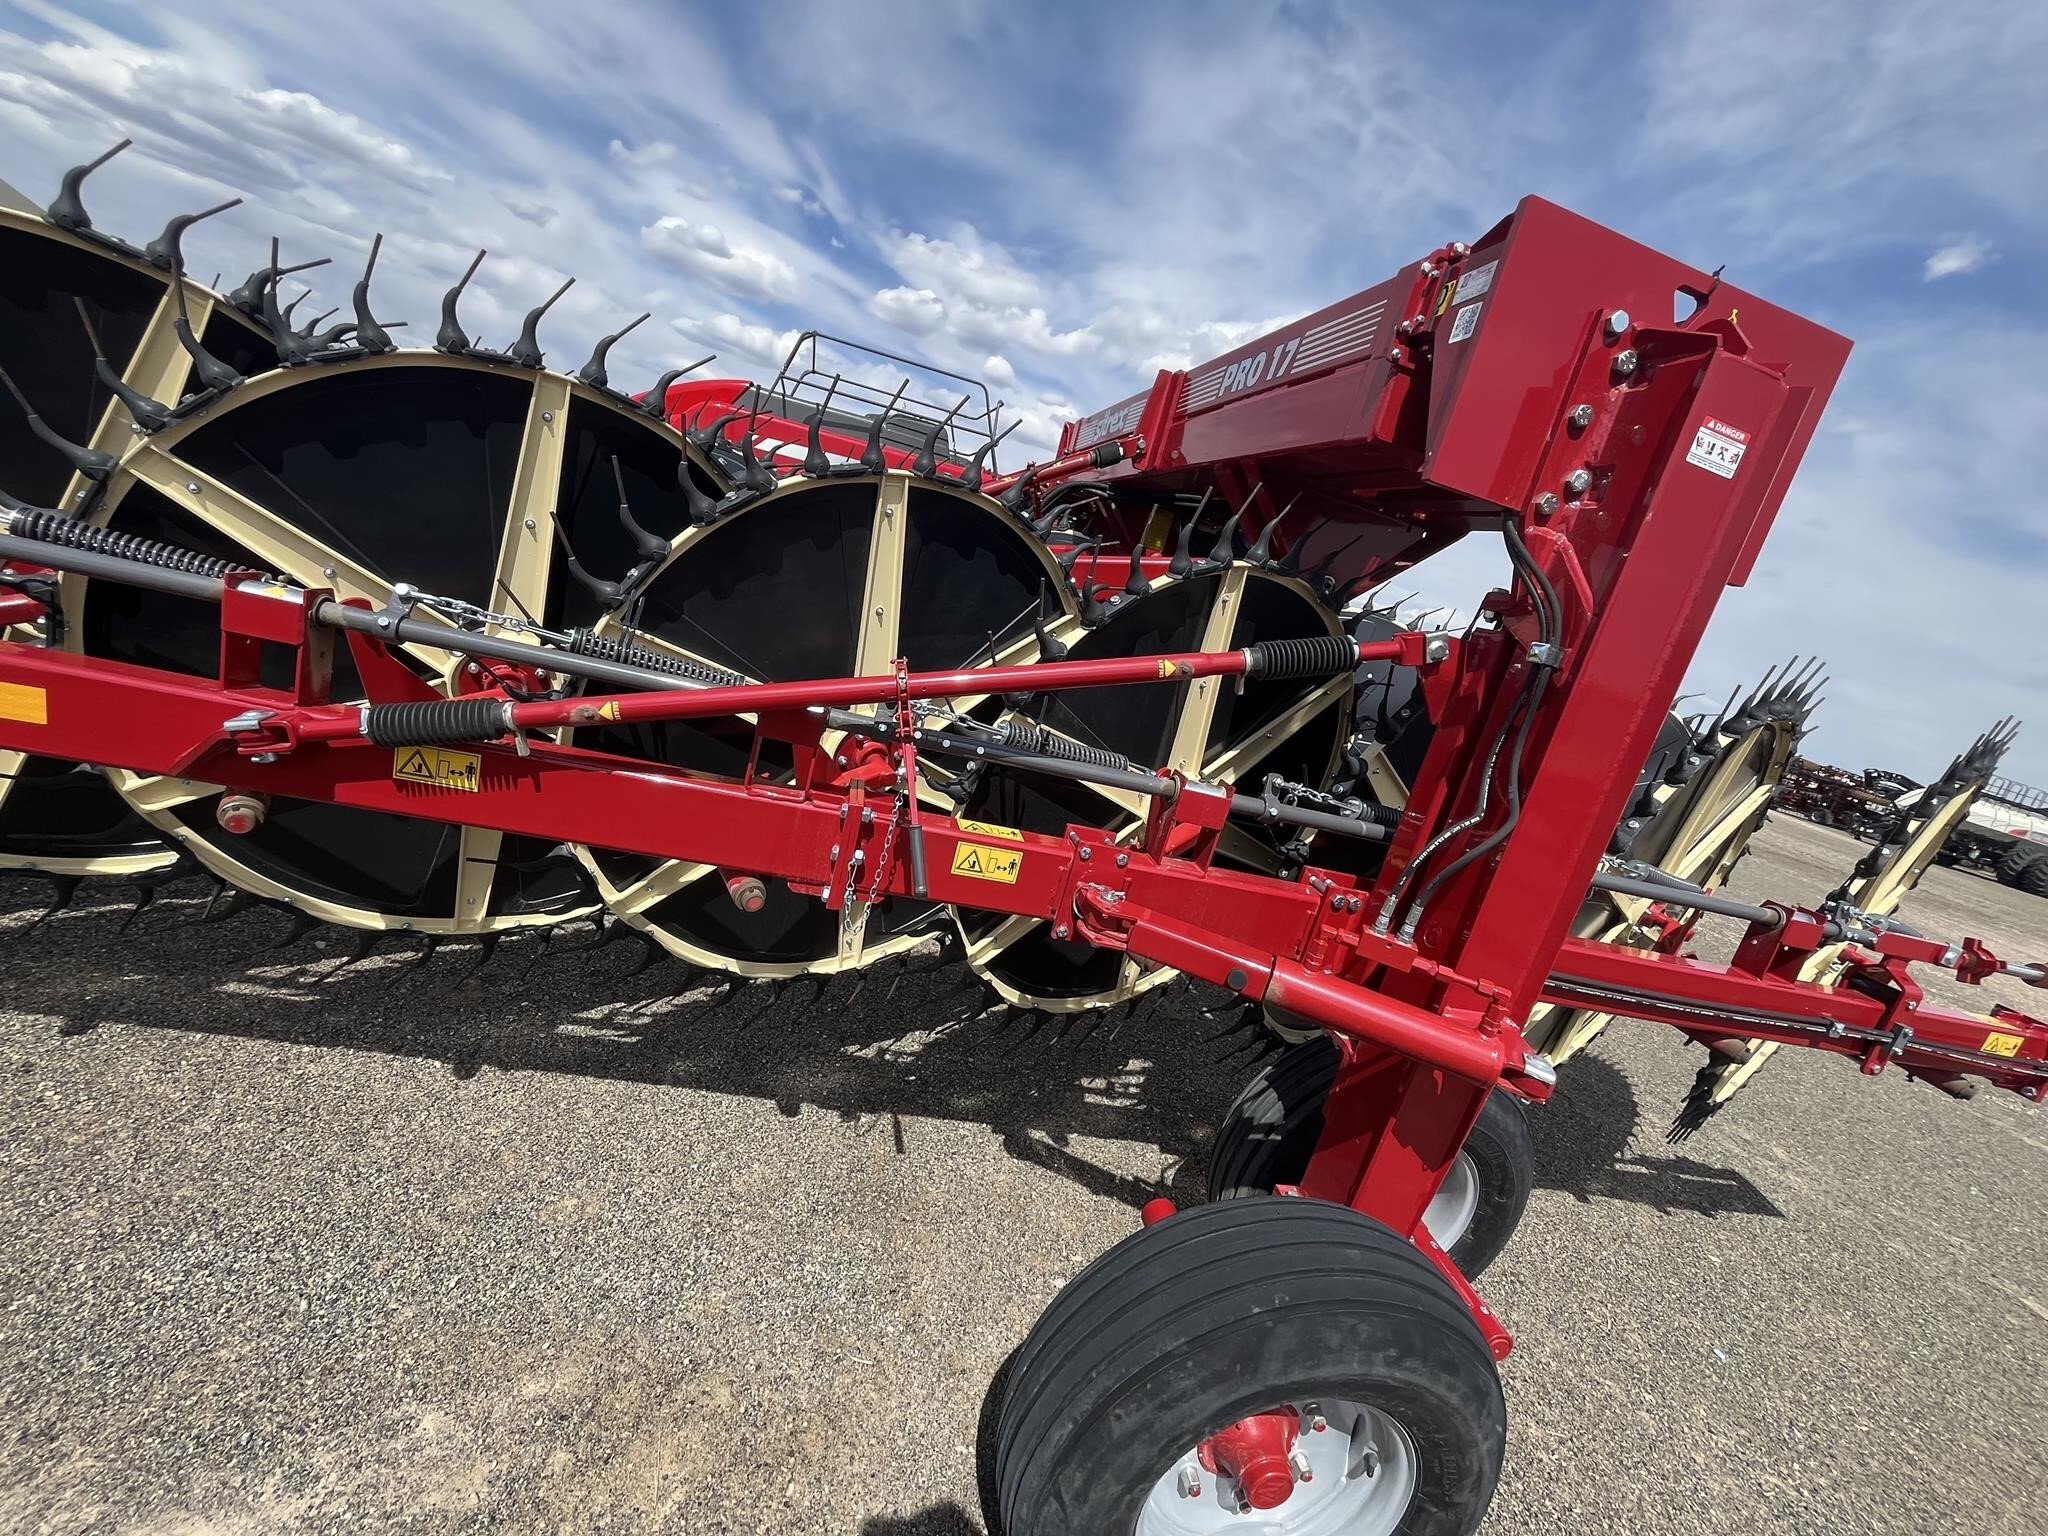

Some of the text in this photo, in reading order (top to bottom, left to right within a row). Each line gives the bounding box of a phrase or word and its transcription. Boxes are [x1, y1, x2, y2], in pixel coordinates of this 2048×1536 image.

[1217, 337, 1301, 397] PRO 17
[1716, 423, 1745, 441] DANGER
